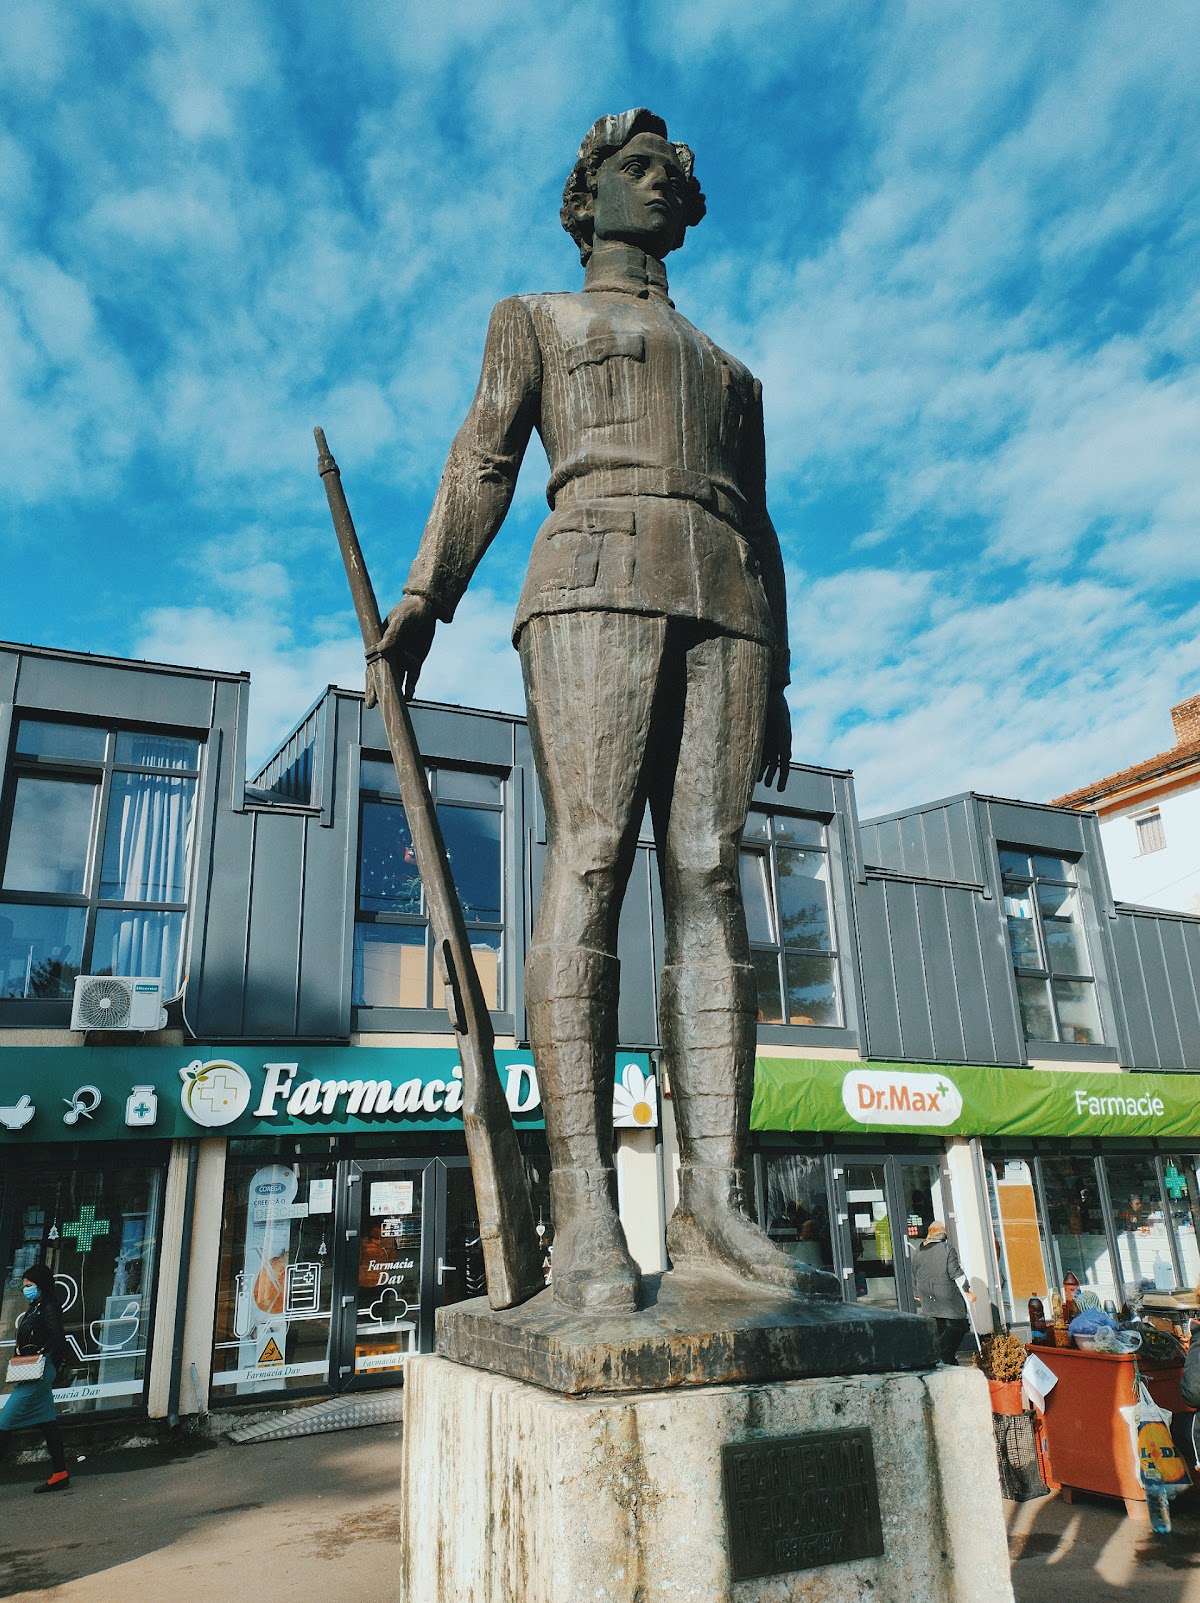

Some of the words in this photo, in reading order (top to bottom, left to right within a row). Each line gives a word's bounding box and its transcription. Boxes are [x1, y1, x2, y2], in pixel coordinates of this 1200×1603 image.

[253, 1062, 463, 1117] Farmaci
[857, 1083, 941, 1112] Dr.Max
[1074, 1090, 1164, 1116] Farmacie
[367, 1257, 414, 1272] Farmacia
[376, 1271, 404, 1286] Dav
[363, 1356, 396, 1368] Farmacia
[246, 1368, 282, 1380] Farmacia
[284, 1366, 301, 1375] Dav
[81, 1387, 100, 1397] Dav
